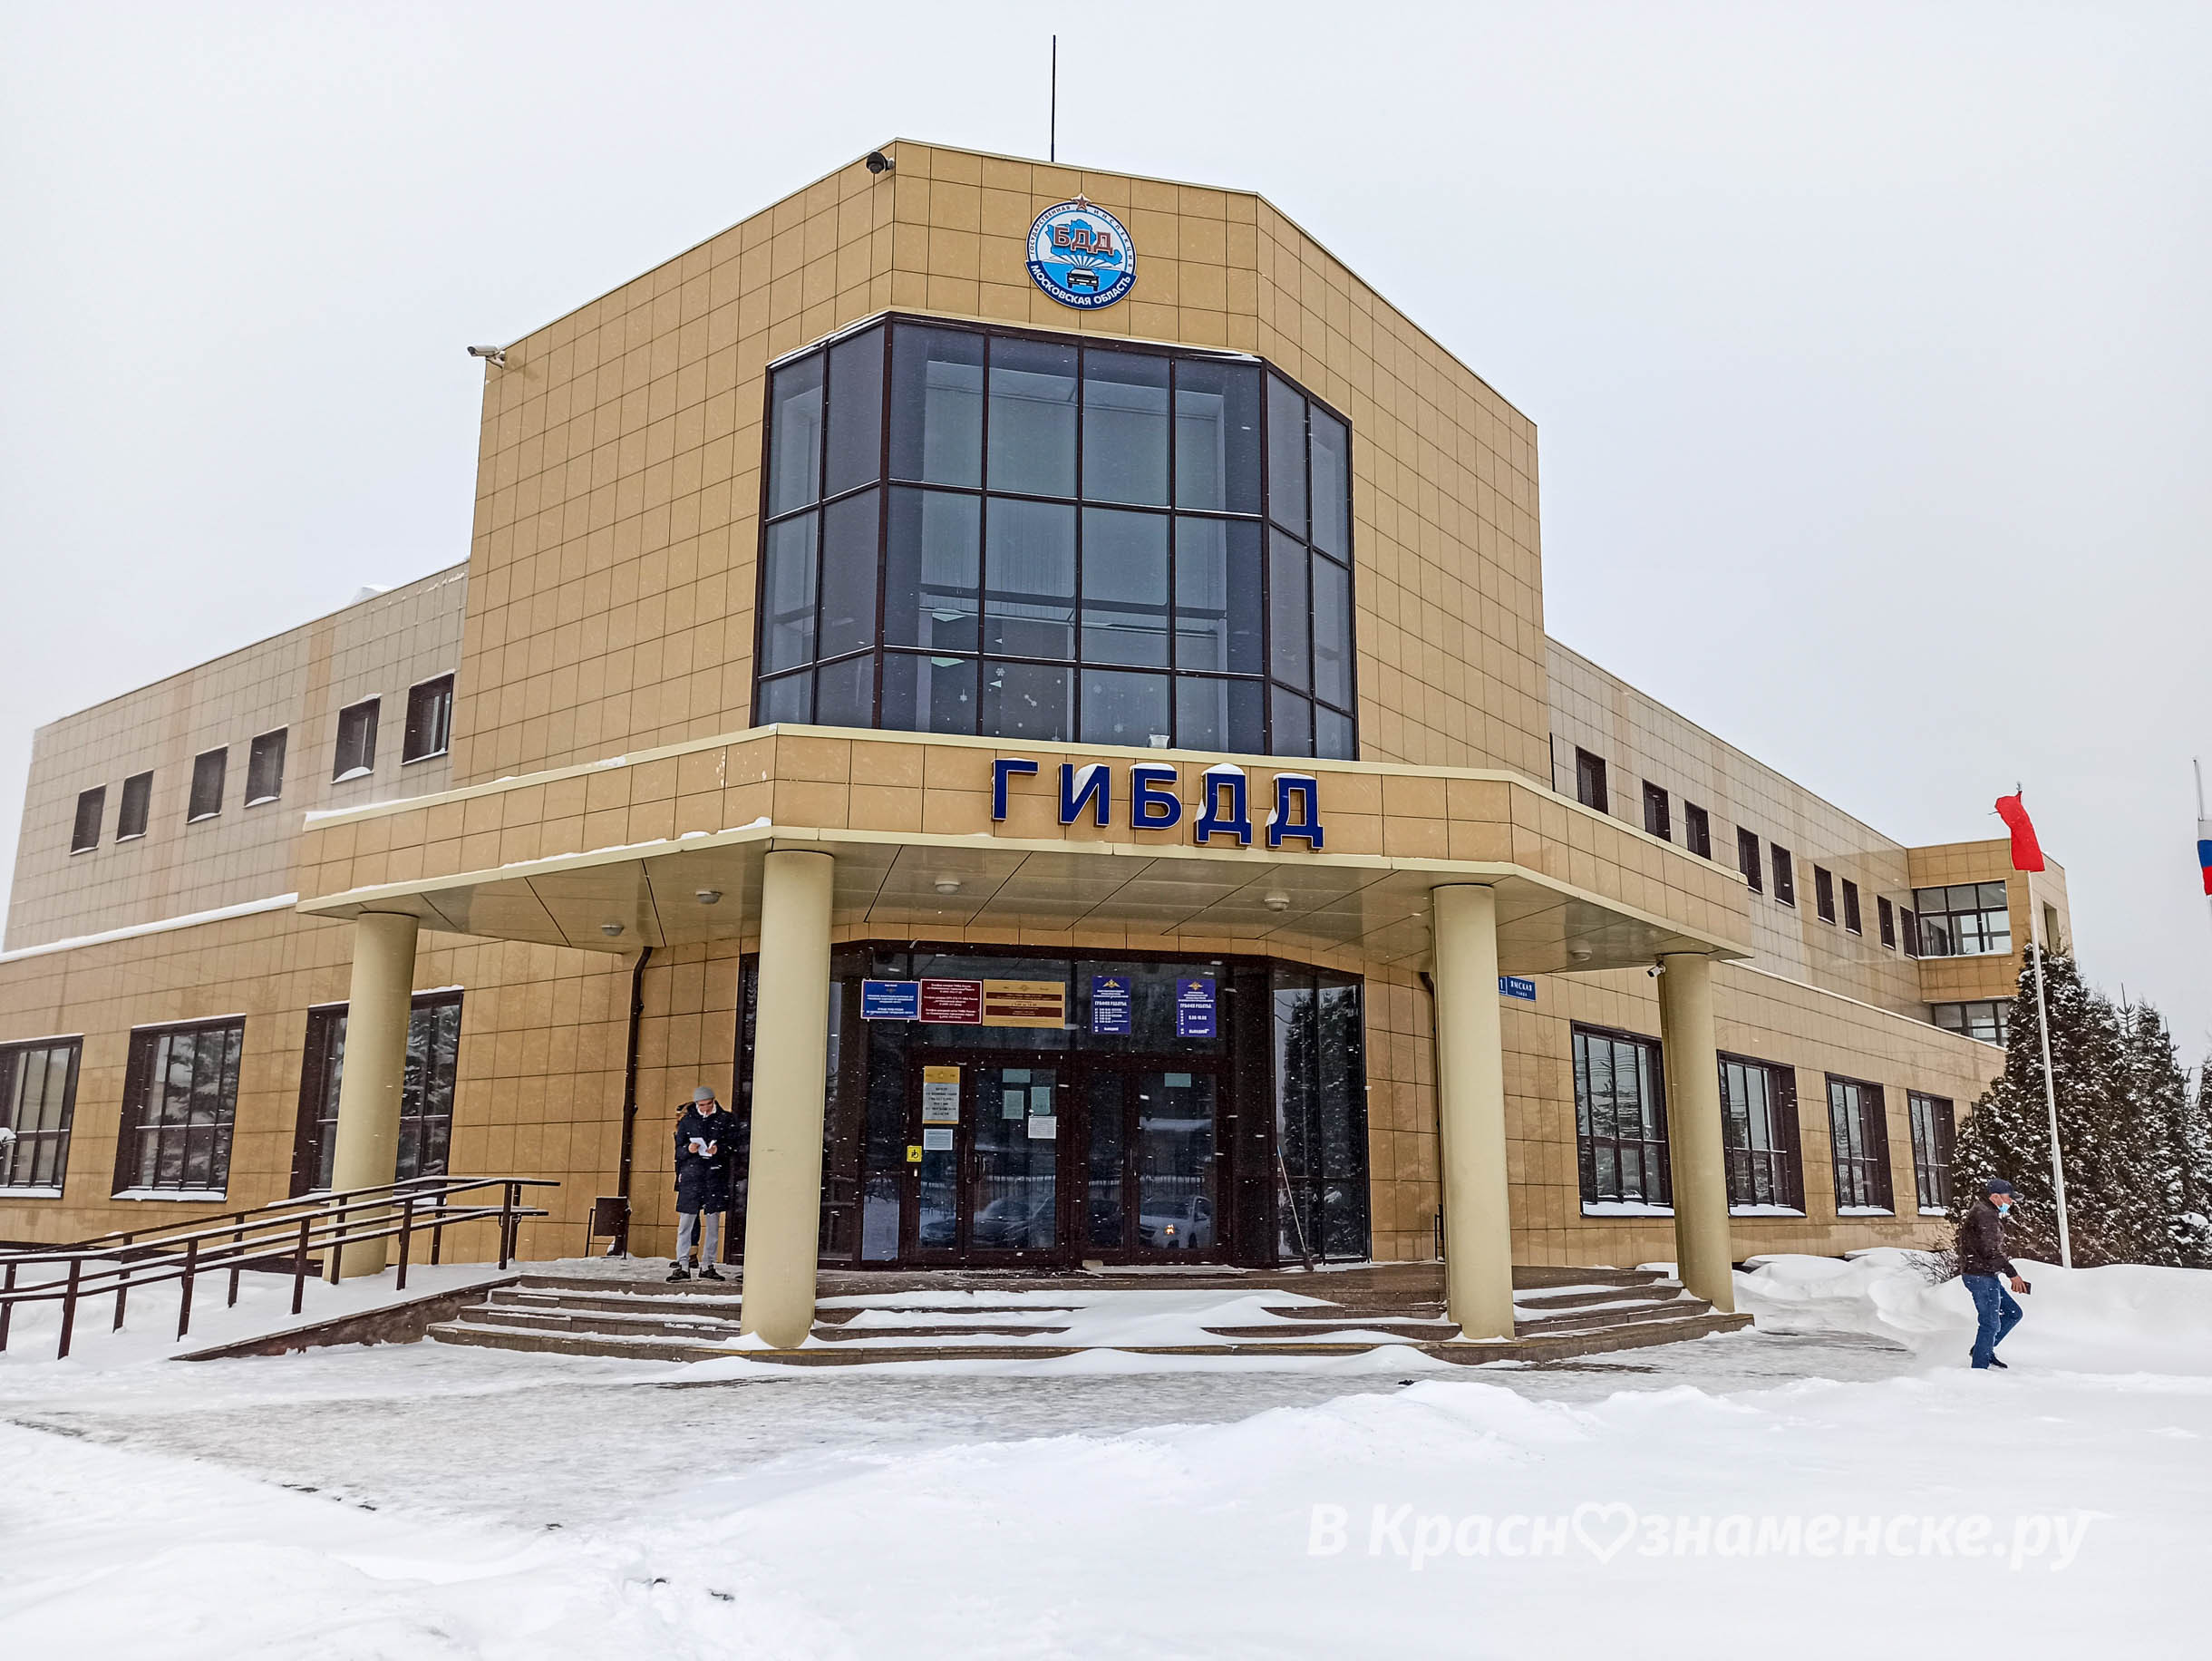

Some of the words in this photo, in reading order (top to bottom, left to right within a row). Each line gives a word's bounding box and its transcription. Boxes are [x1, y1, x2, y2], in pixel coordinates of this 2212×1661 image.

[1030, 205, 1071, 255] ГОСУДАРСТВЕННАЯ
[1093, 209, 1132, 268] ИНСПЕКЦИЯ
[1054, 226, 1113, 256] БДД
[1031, 265, 1091, 306] МОСКОВСКАЯ
[1093, 276, 1131, 305] ОБЛАСТЬ
[992, 758, 1325, 850] ГИБДД
